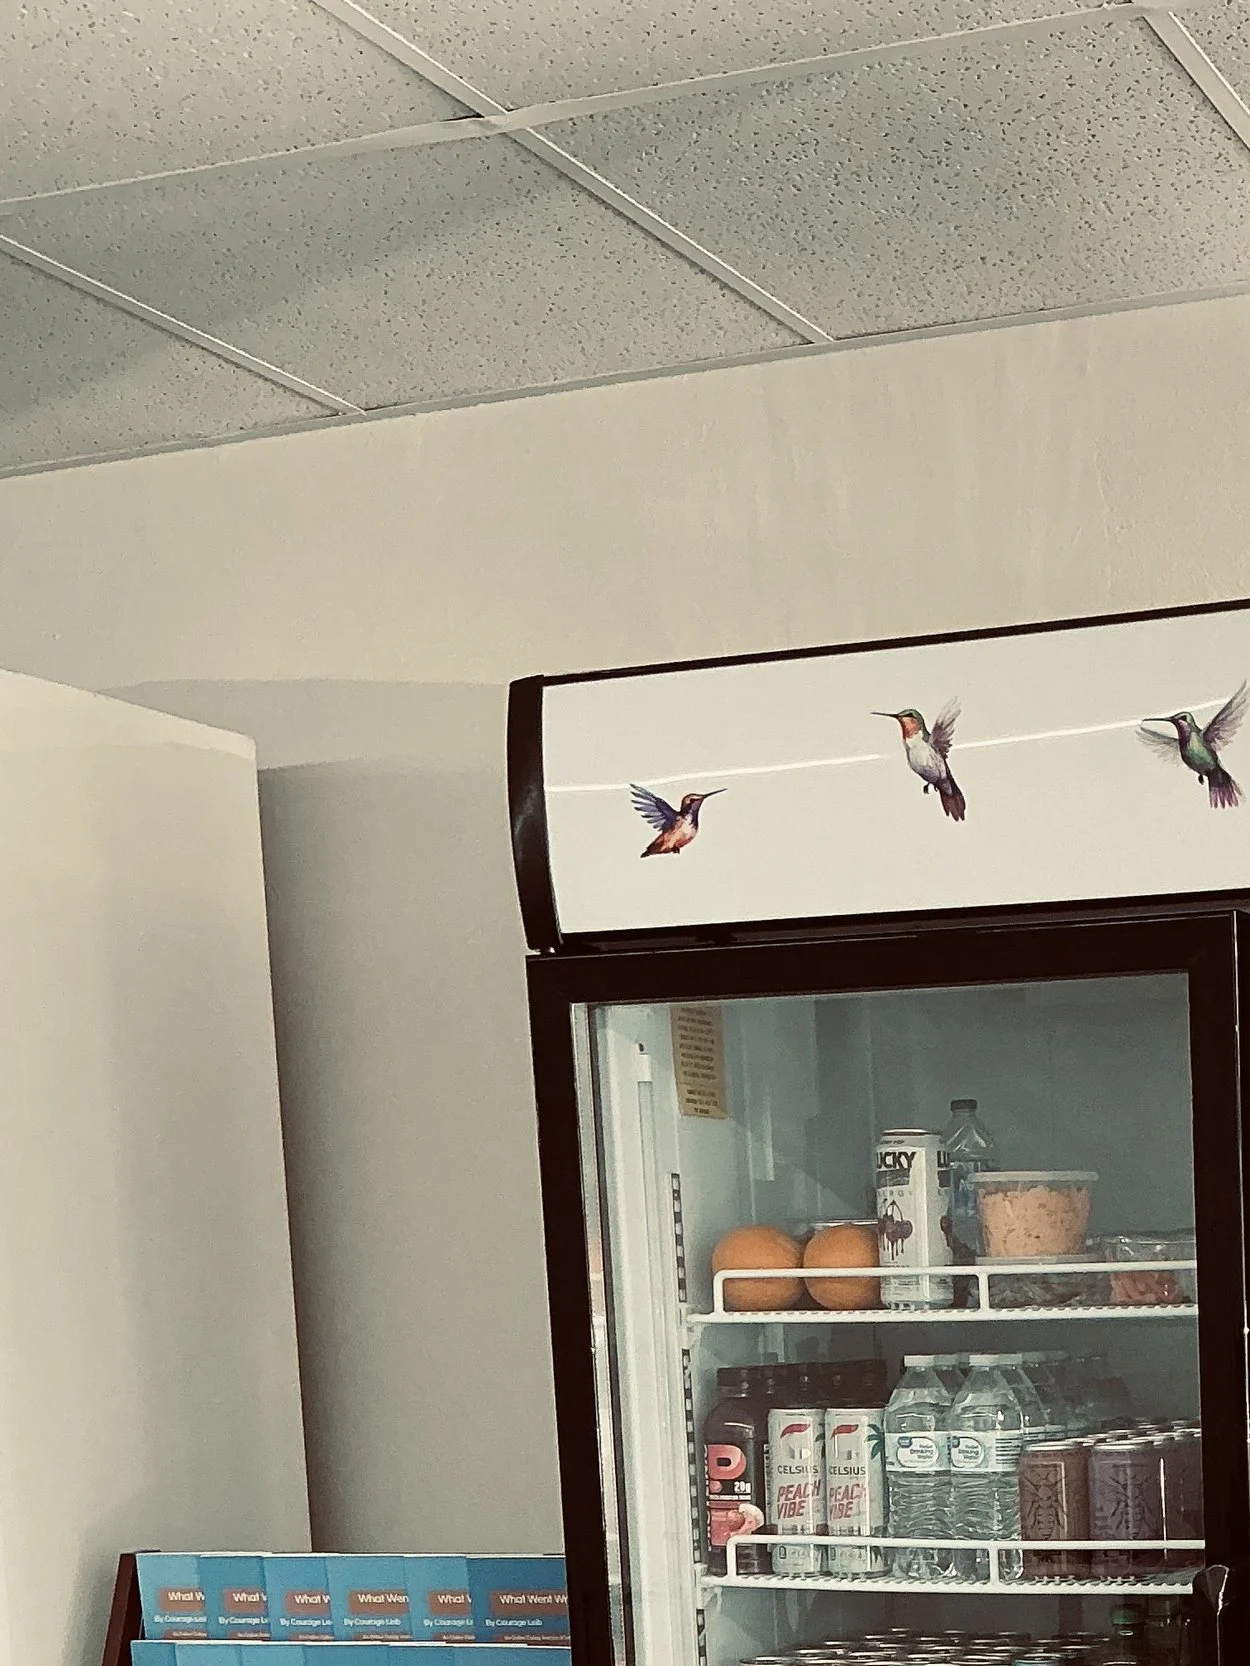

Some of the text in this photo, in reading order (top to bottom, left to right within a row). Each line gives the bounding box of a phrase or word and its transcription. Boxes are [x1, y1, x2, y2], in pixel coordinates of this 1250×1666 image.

[777, 1464, 818, 1475] CELSIUS
[777, 1479, 821, 1503] PEACH
[777, 1499, 807, 1520] VIBE
[358, 1594, 409, 1603] What Wen
[438, 1594, 464, 1604] What
[500, 1594, 552, 1604] What Went
